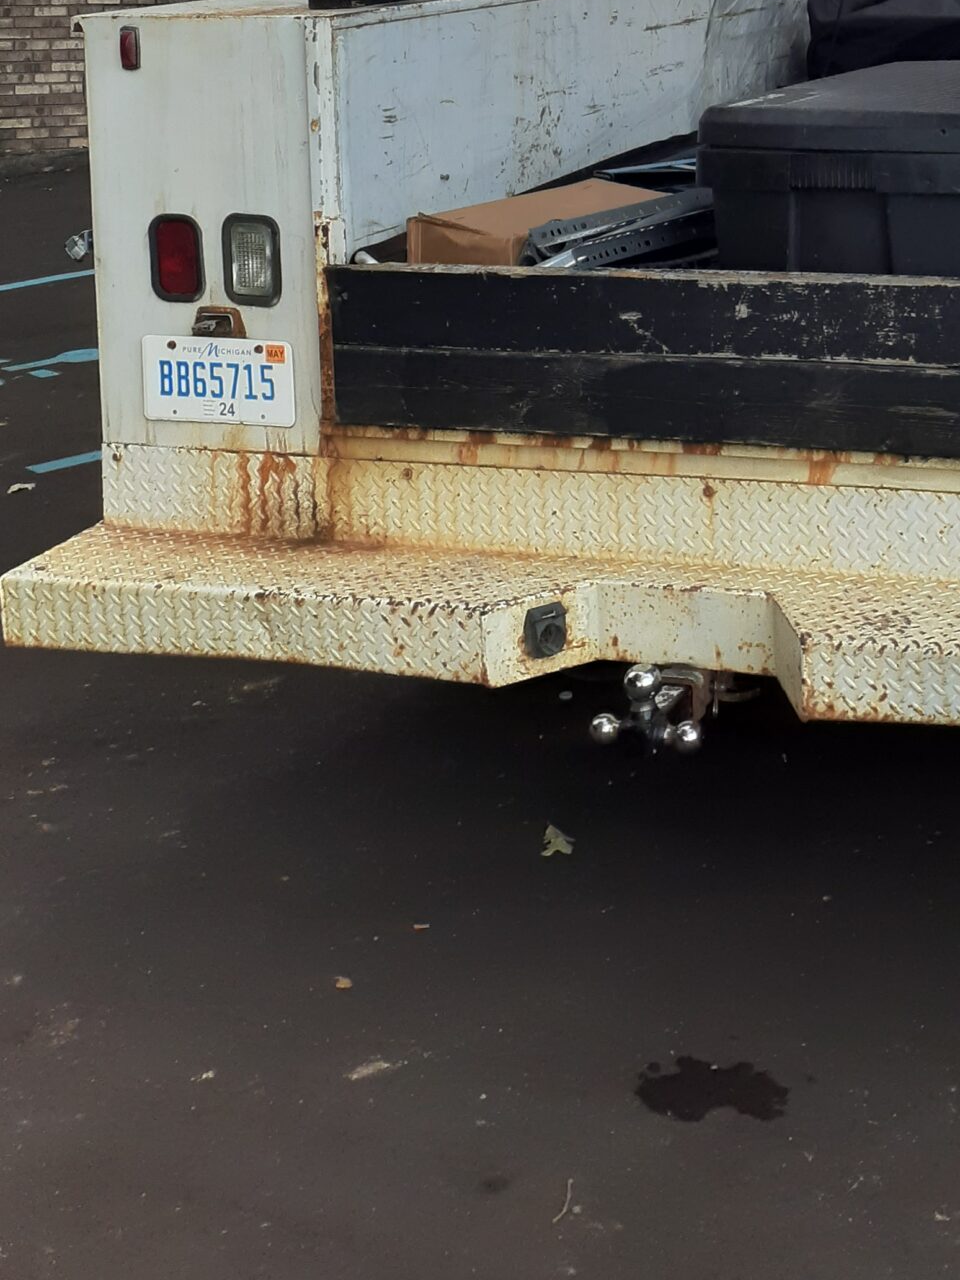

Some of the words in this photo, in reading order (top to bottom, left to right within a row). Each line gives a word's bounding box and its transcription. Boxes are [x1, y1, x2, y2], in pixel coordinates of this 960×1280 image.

[182, 346, 202, 354] PURE
[267, 349, 285, 359] MAY
[159, 359, 275, 401] BB65715
[219, 402, 236, 416] 24
